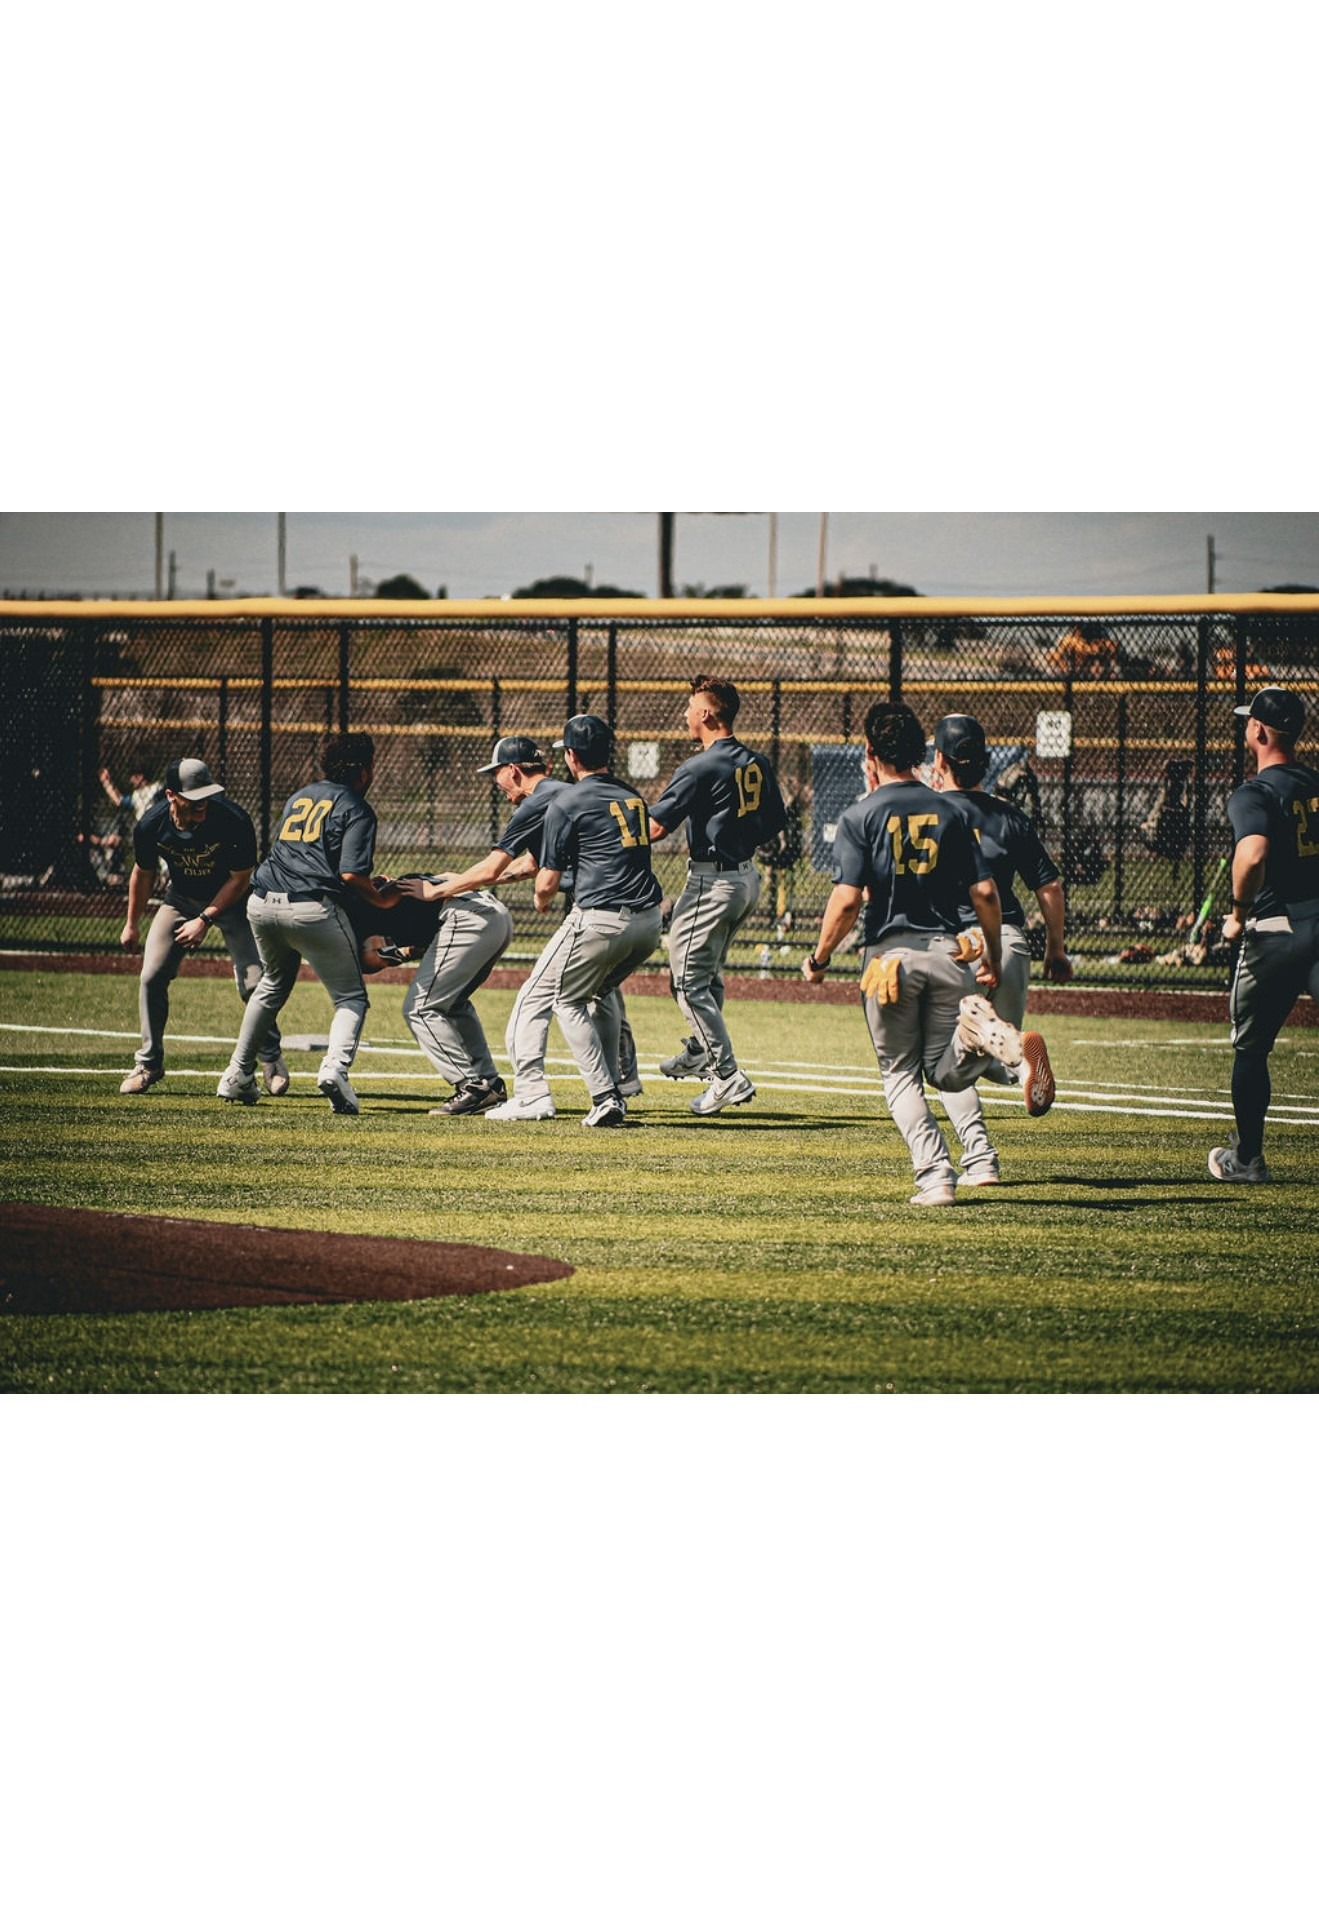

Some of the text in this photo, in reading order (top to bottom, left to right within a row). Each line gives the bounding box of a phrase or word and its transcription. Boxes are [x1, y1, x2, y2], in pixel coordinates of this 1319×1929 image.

[735, 763, 763, 817] 19
[279, 797, 333, 843] 20
[609, 797, 649, 848] 17
[886, 813, 939, 875] 15
[1292, 797, 1319, 857] 2
